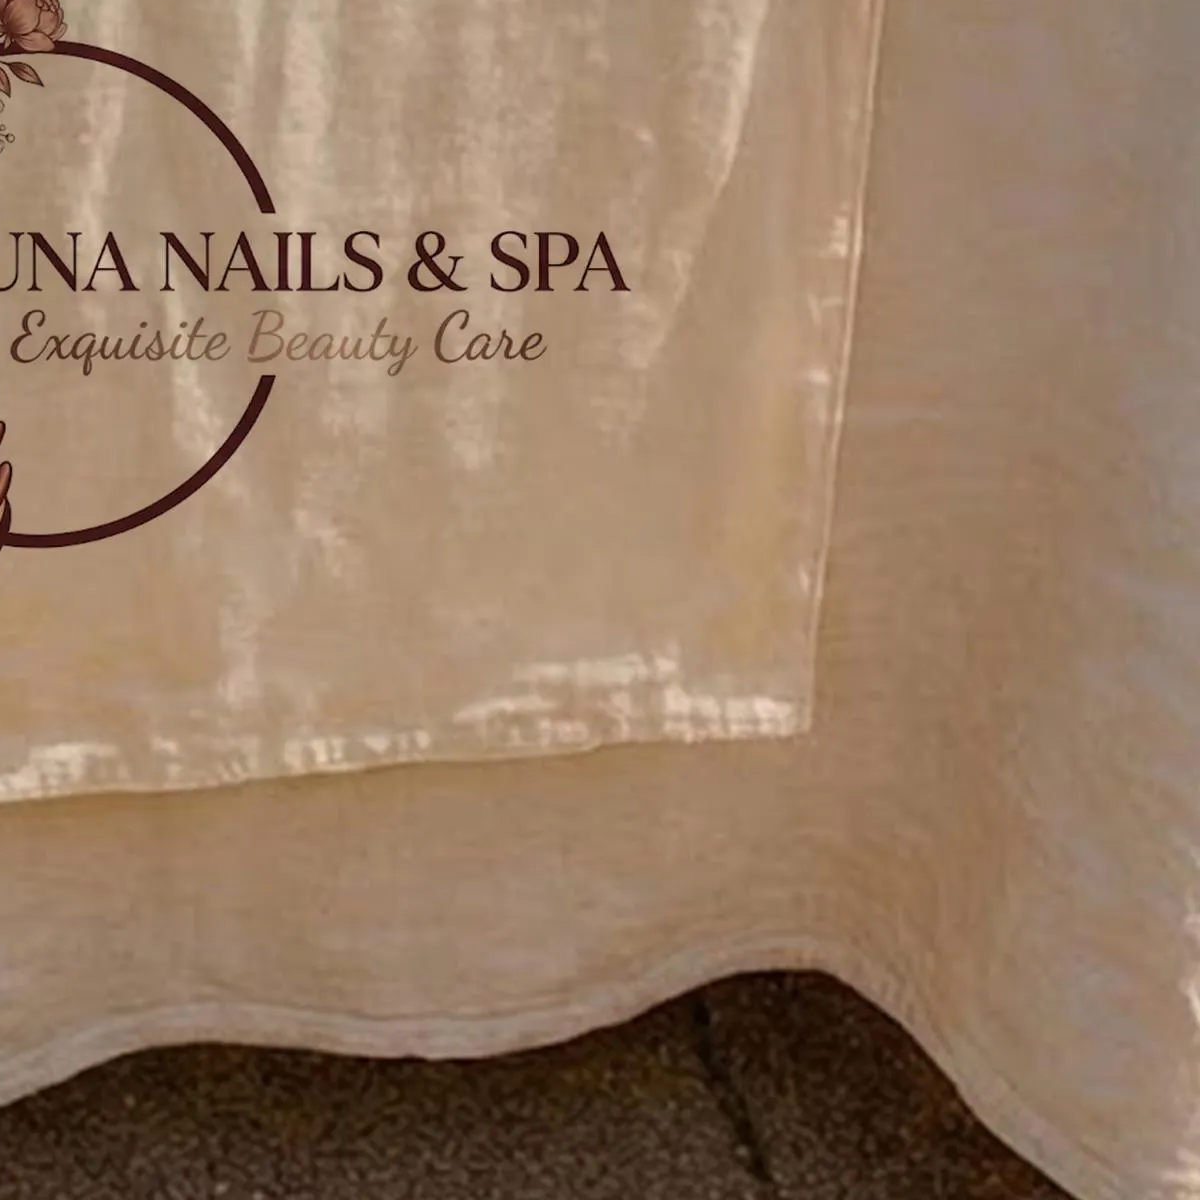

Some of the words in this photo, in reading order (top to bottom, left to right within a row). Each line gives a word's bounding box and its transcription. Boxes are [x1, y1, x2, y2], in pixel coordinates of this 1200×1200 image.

[160, 231, 385, 293] NAILS
[407, 231, 468, 293] &
[489, 231, 631, 293] SPA
[10, 309, 231, 377] Exquisite
[246, 309, 417, 377] Beauty
[433, 308, 548, 364] Care
